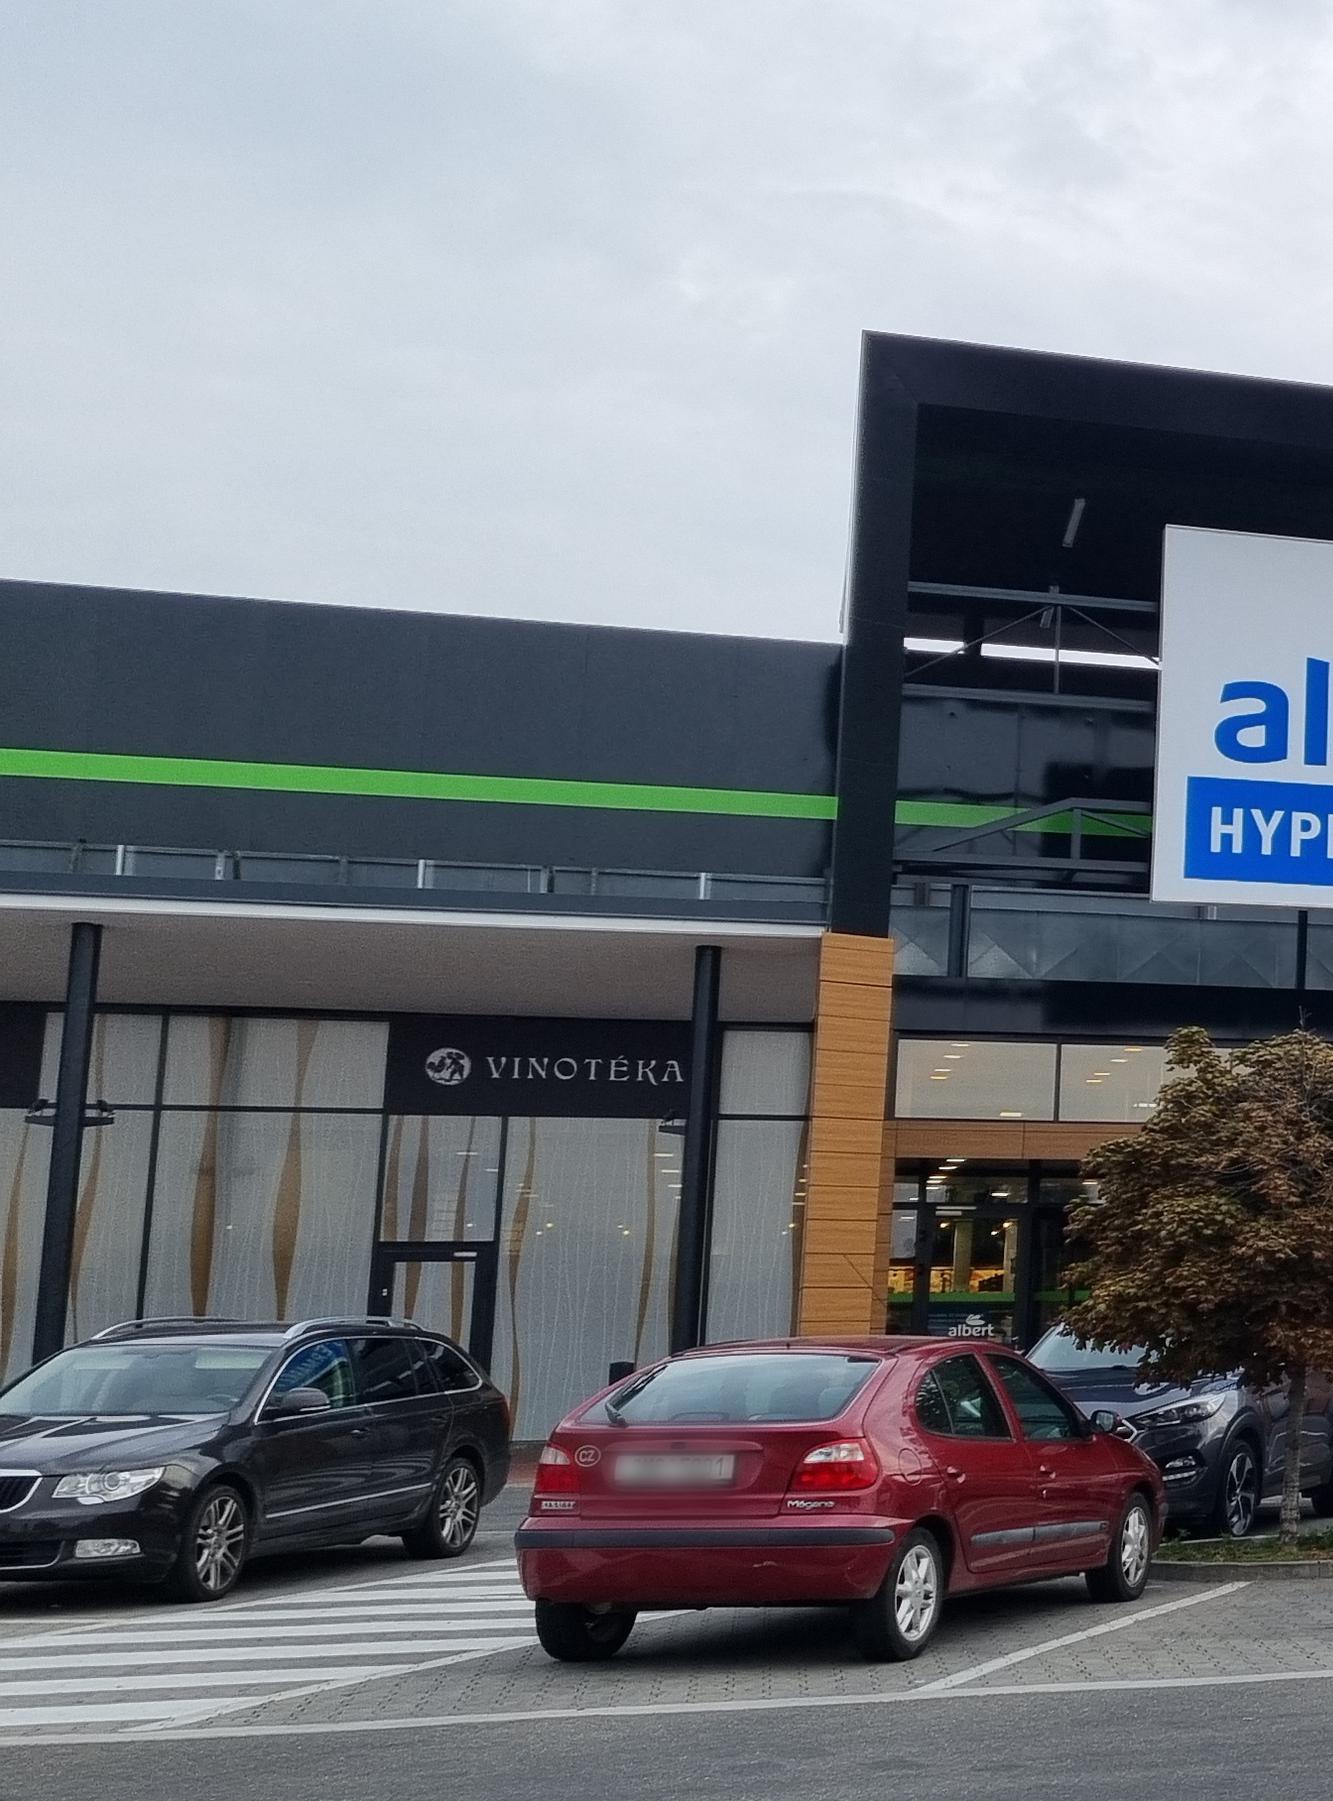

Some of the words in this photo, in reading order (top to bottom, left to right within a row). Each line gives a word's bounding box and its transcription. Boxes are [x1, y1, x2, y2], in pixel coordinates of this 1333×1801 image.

[486, 1055, 684, 1086] VINOTÉKA
[947, 1323, 995, 1337] albert
[580, 1449, 597, 1463] CZ
